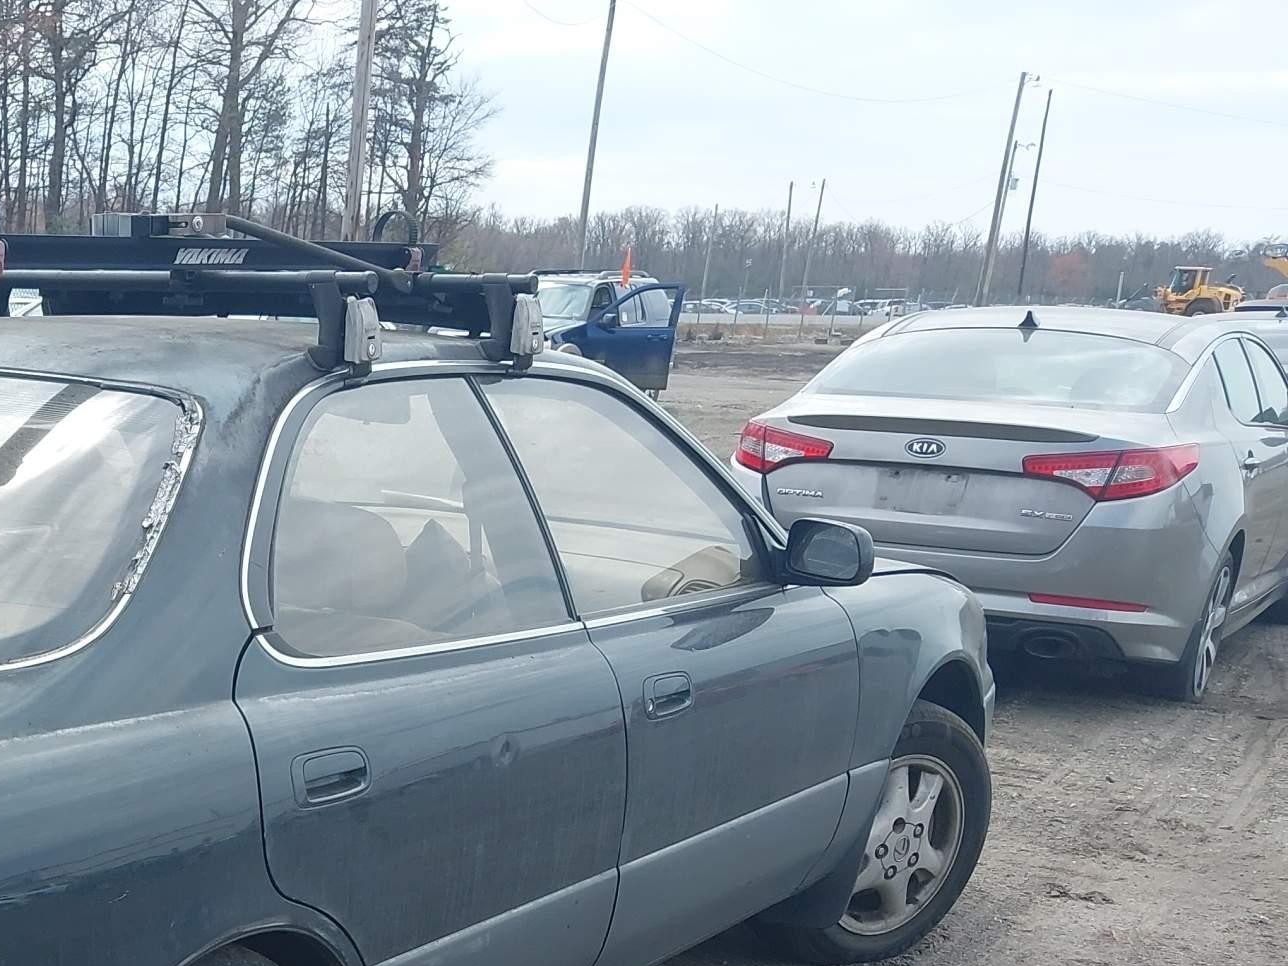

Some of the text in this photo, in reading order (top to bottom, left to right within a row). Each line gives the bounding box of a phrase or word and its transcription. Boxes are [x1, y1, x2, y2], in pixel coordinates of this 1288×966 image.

[173, 247, 249, 265] YAKIMA
[912, 442, 938, 453] KIA
[776, 487, 824, 498] OPTIMA
